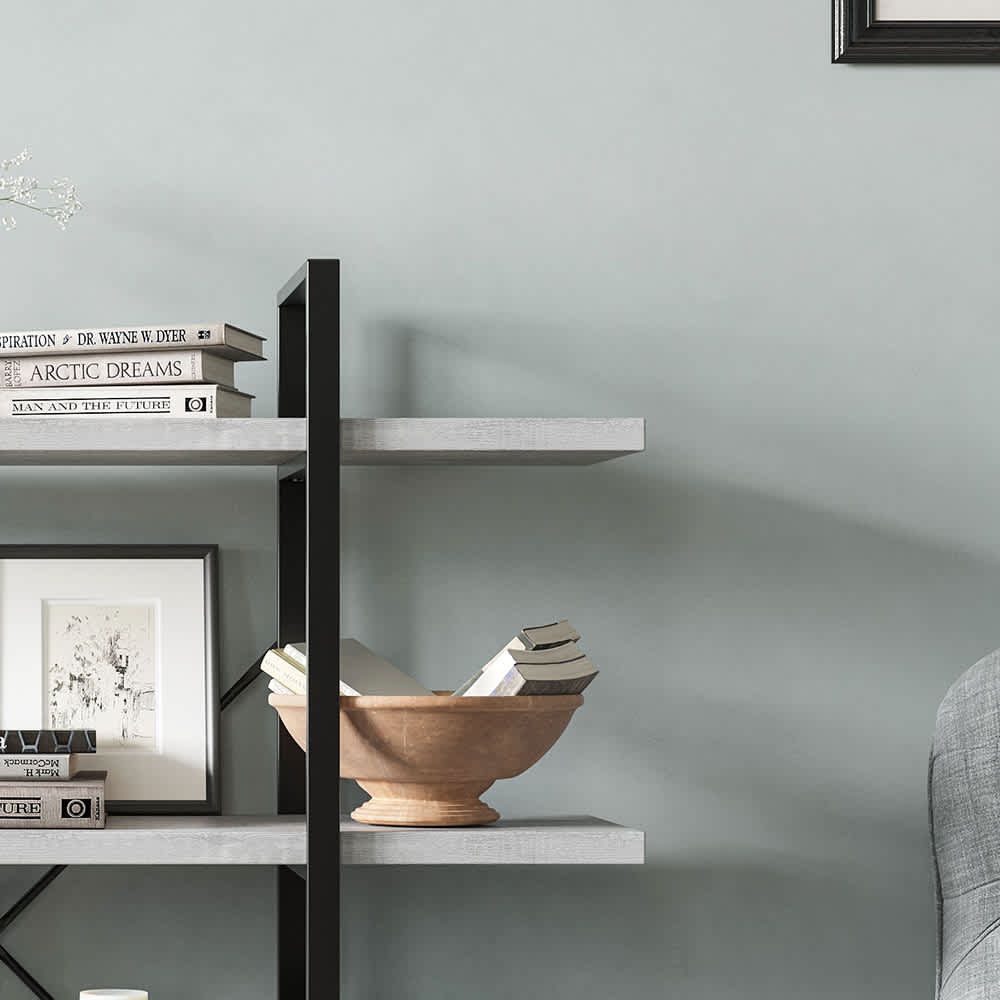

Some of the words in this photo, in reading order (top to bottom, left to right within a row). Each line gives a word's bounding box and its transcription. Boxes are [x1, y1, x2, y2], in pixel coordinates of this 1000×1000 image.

[77, 332, 96, 345] DR.
[98, 331, 138, 344] WAYNE
[140, 330, 153, 343] W.
[155, 328, 187, 343] DYER
[13, 360, 21, 387] LOPEZ
[30, 362, 99, 381] ARCTIC
[107, 360, 182, 378] DREAMS
[12, 400, 45, 413] MAN
[48, 400, 78, 412] AND
[81, 400, 111, 412] THE
[115, 400, 171, 411] FUTURE
[4, 759, 60, 768] McCormack
[24, 768, 33, 777] H.
[35, 768, 60, 777] Mark
